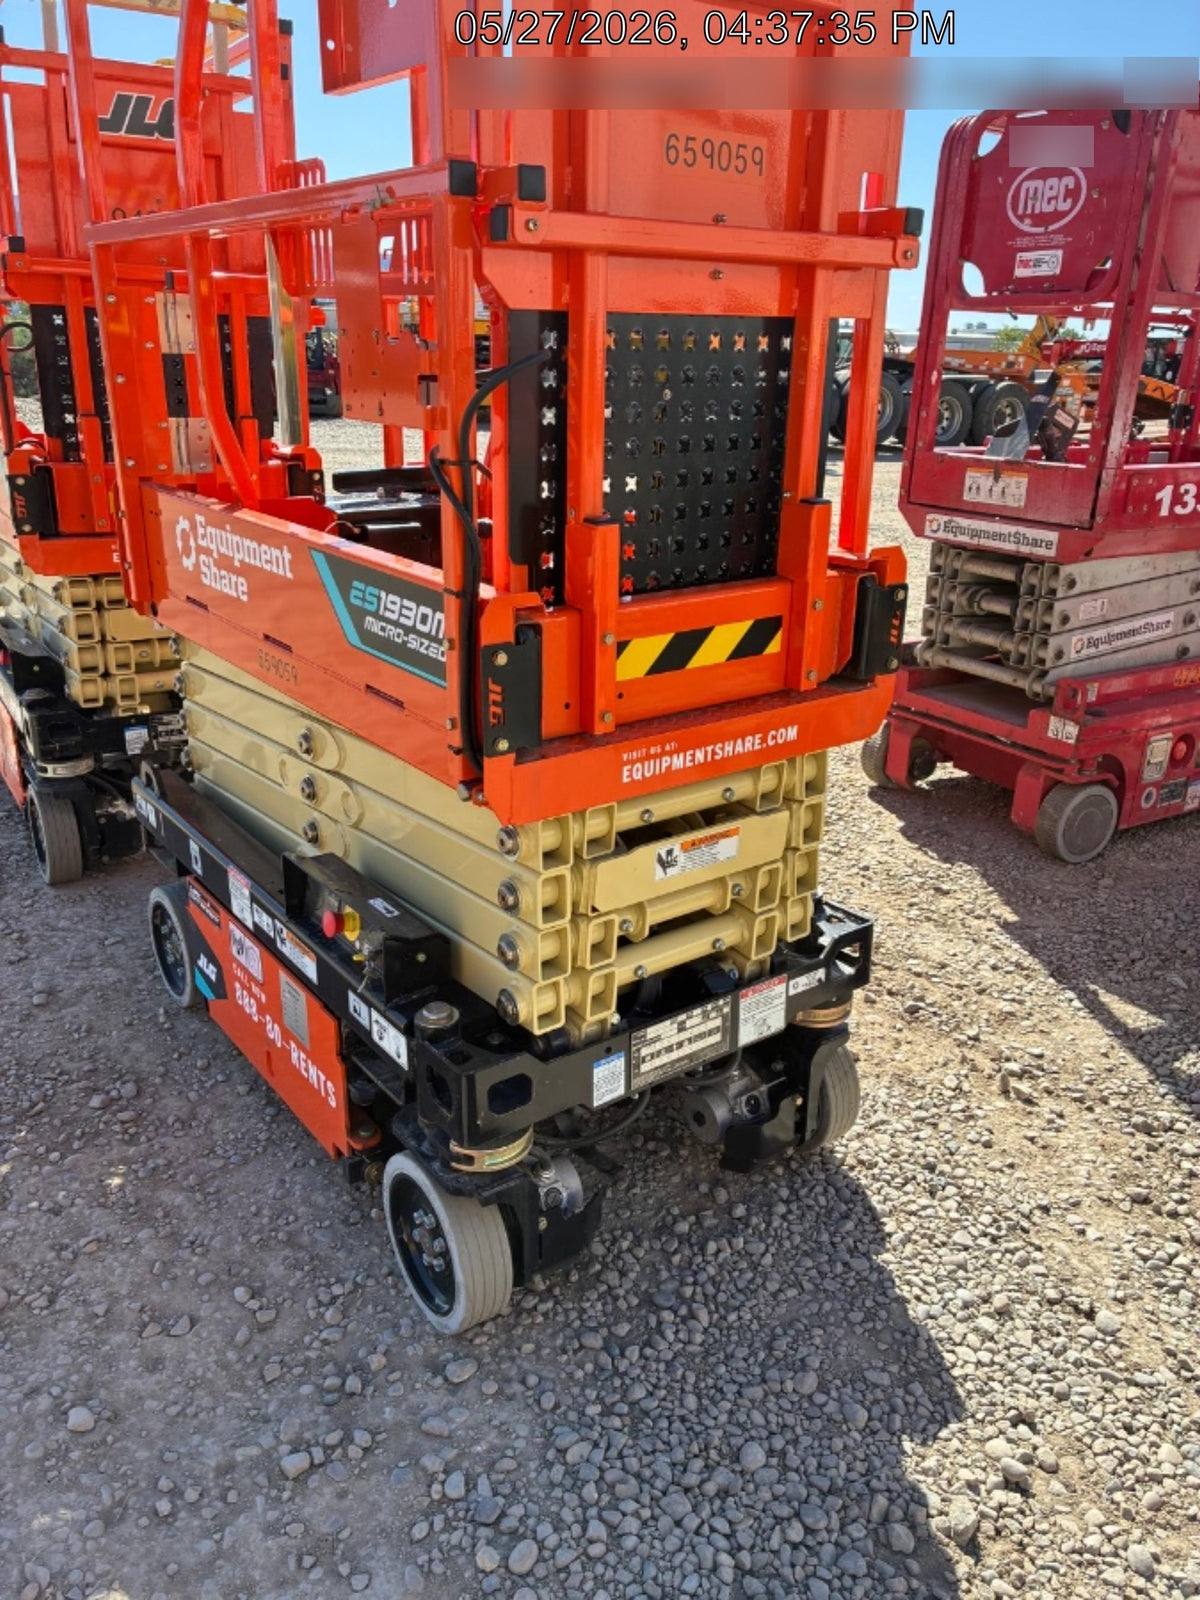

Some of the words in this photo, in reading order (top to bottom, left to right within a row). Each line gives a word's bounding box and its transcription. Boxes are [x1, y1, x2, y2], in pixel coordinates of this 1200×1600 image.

[665, 133, 764, 176] 659059
[1155, 482, 1200, 516] 13
[195, 513, 294, 579] Equipment
[942, 519, 1054, 550] EquipmentShare
[199, 553, 248, 602] Share
[488, 676, 505, 728] JLG
[621, 746, 647, 762] VISIT
[650, 745, 662, 755] US
[621, 724, 799, 784] EQUIPMENTSHARE.COM
[234, 980, 338, 1109] 888-80-RENTS
